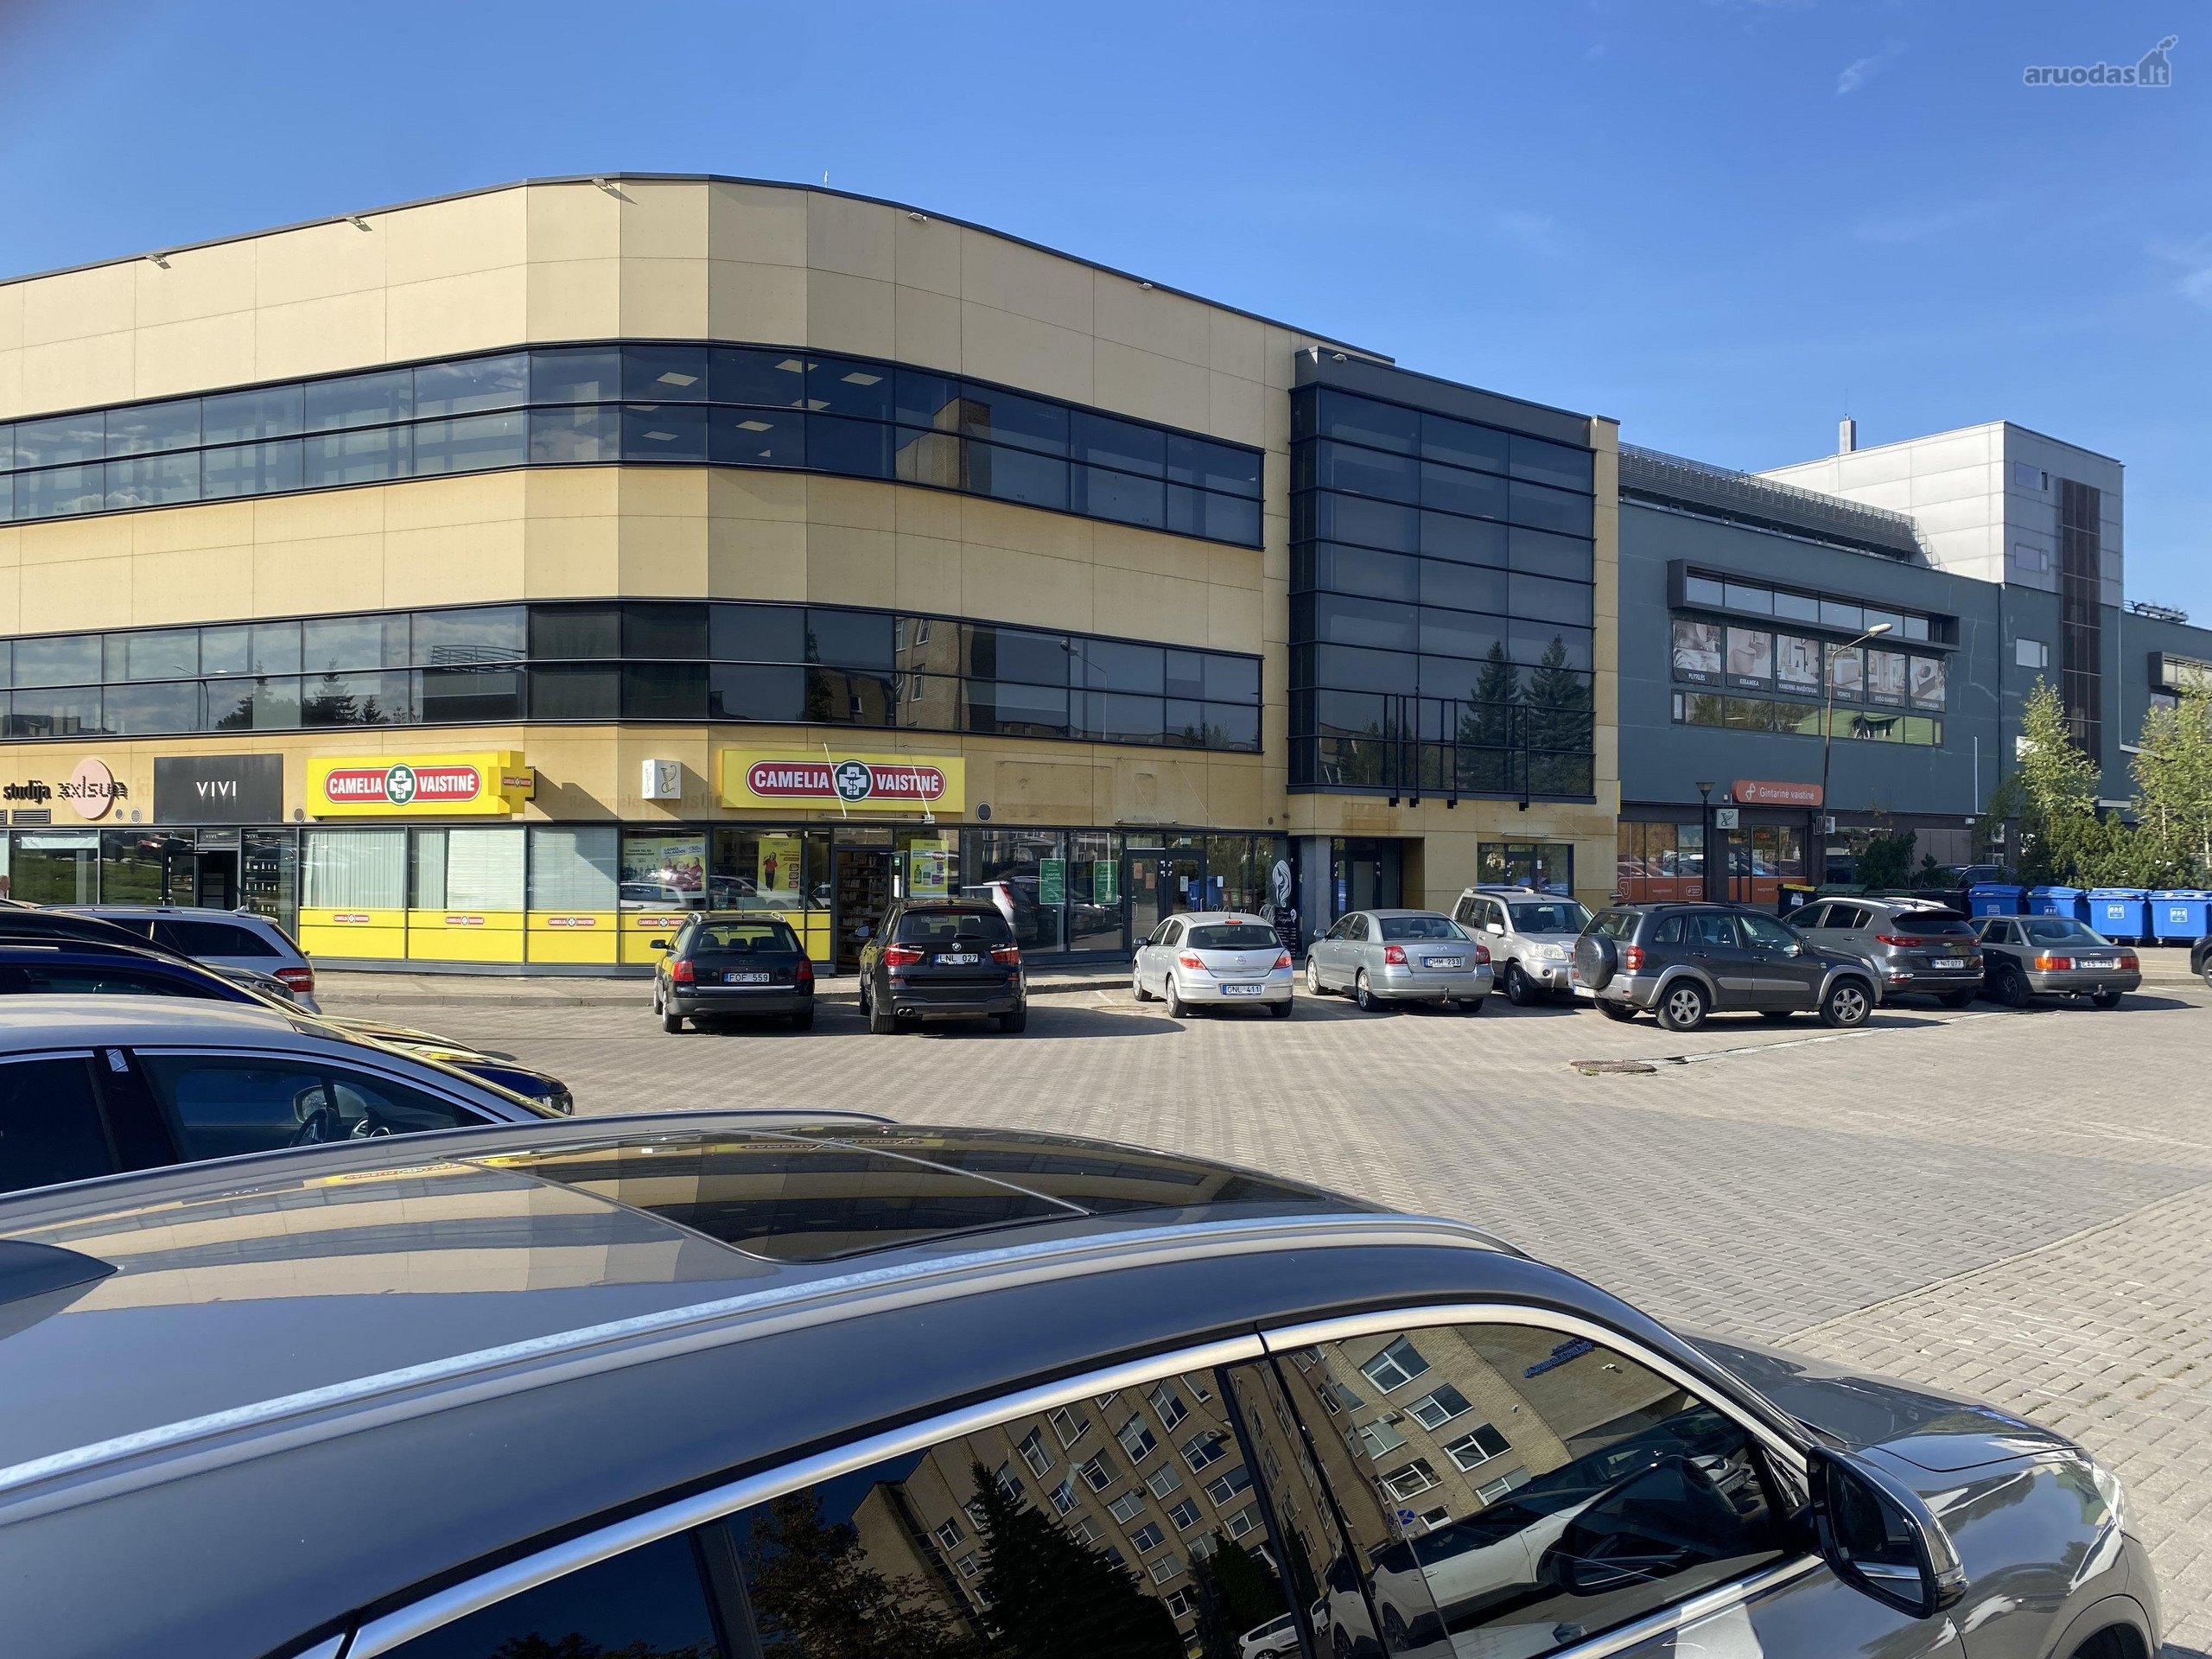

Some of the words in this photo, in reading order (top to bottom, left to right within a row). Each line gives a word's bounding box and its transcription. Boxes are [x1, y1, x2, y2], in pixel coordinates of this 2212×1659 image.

[1739, 678, 1759, 687] KERAMIKA
[195, 780, 238, 798] VIVI
[329, 777, 383, 794] CAMELIA
[419, 772, 475, 792] VAISTINĖ
[754, 770, 830, 789] CAMELIA
[875, 773, 939, 792] VAISTINĖ
[3, 779, 53, 804] studija
[1759, 786, 1789, 798] Gintarinė
[1790, 789, 1815, 800] vaistinė
